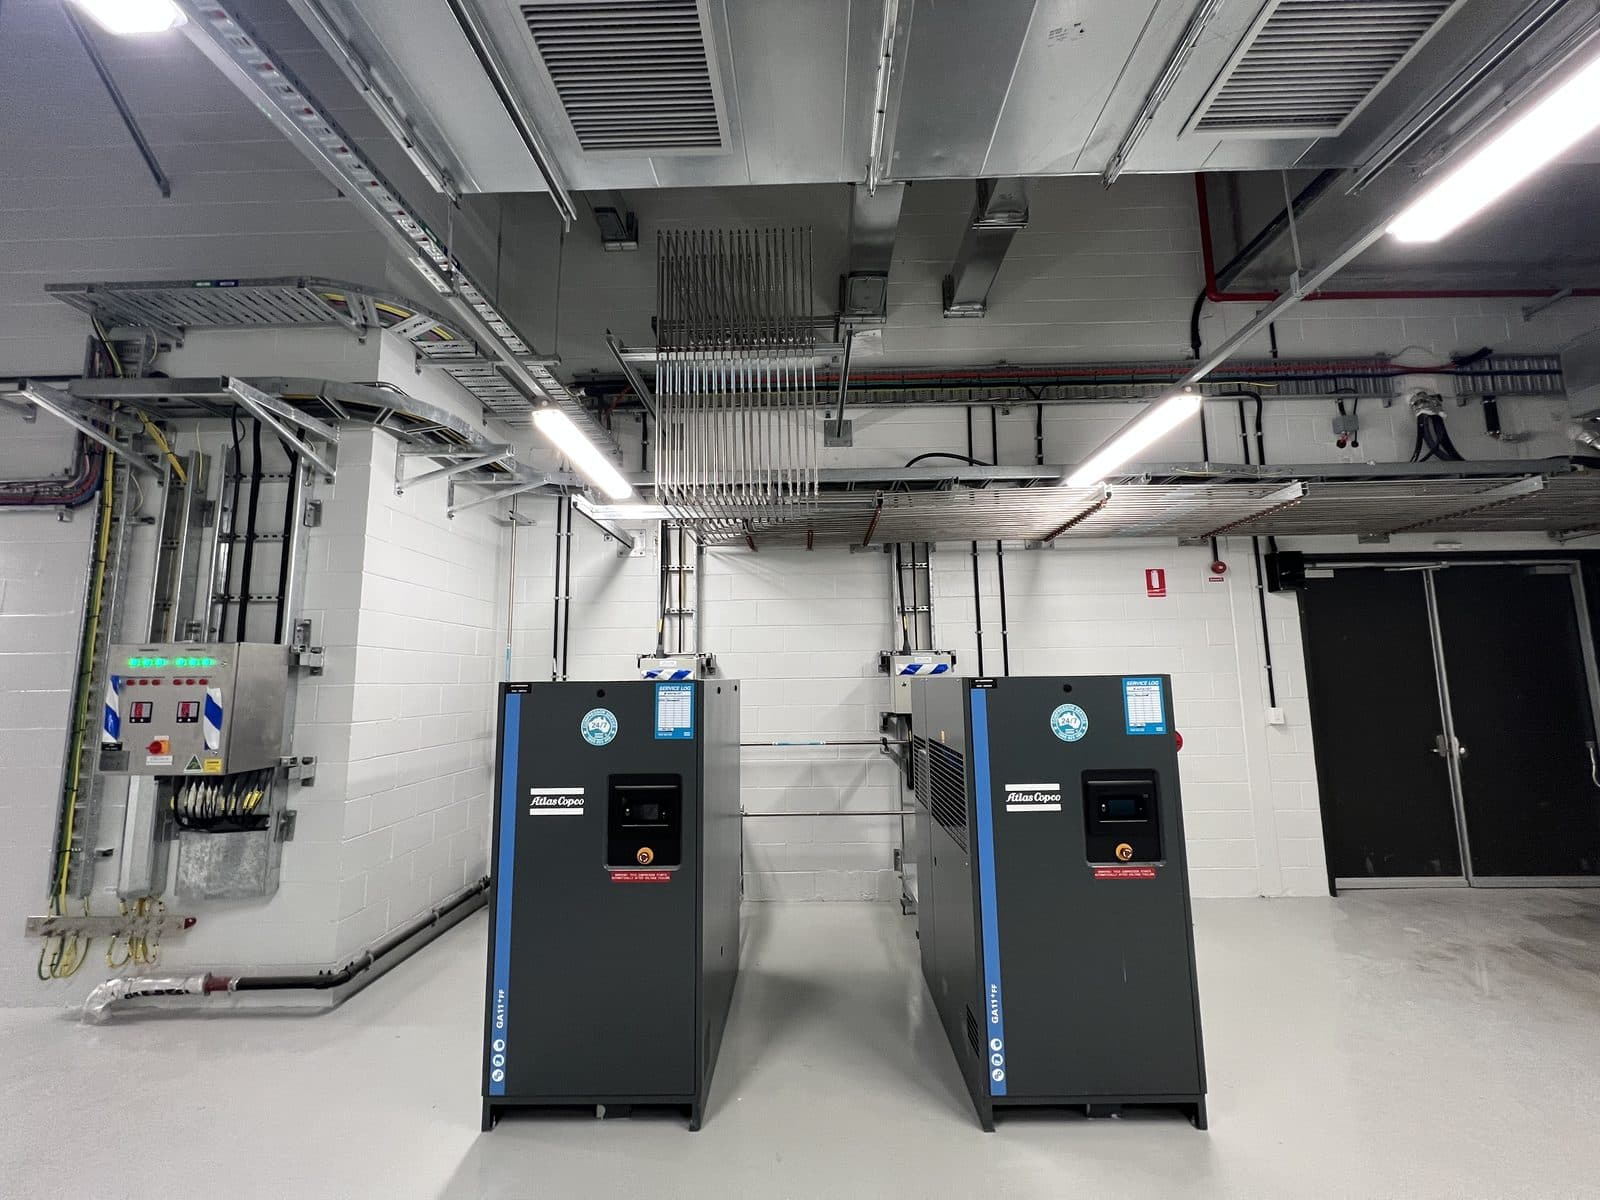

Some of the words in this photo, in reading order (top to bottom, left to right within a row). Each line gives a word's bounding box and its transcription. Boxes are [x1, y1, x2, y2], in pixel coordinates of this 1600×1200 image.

[530, 796, 557, 806] Atlas
[558, 796, 585, 807] Copco
[1006, 792, 1033, 802] Atlas
[1034, 792, 1061, 803] Copco
